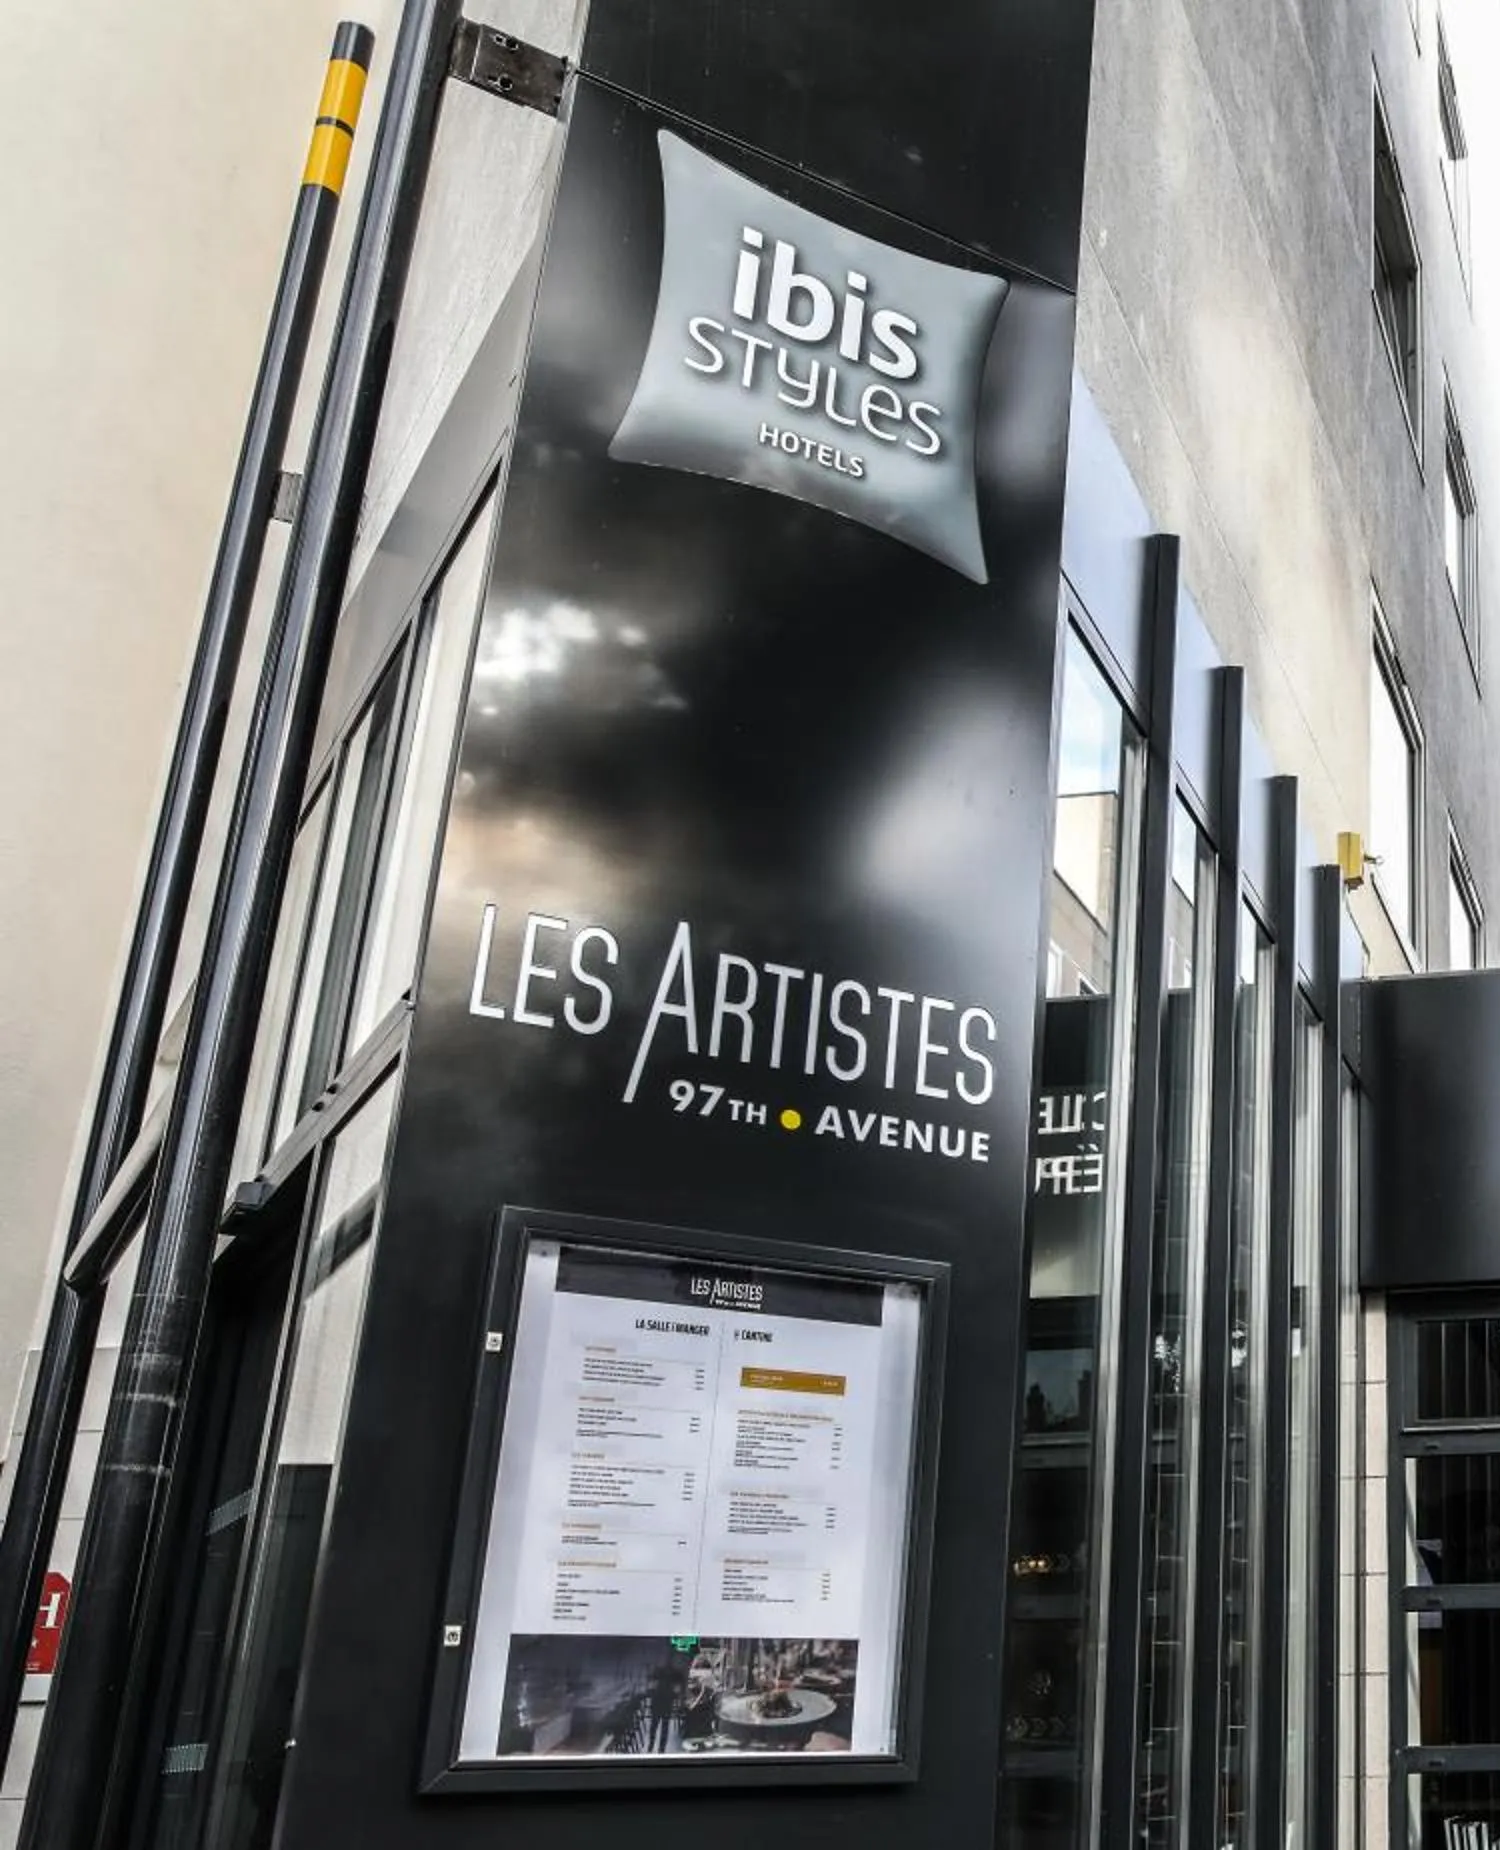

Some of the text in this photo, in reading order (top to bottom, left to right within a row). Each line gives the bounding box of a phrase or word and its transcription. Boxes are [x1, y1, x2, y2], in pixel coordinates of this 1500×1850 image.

[734, 226, 918, 379] ibis
[758, 422, 865, 478] HOTELS
[468, 903, 997, 1106] LES ARTISTES
[815, 1105, 991, 1163] AVENUE
[691, 1276, 710, 1295] LES
[709, 1277, 763, 1305] ARTISTES
